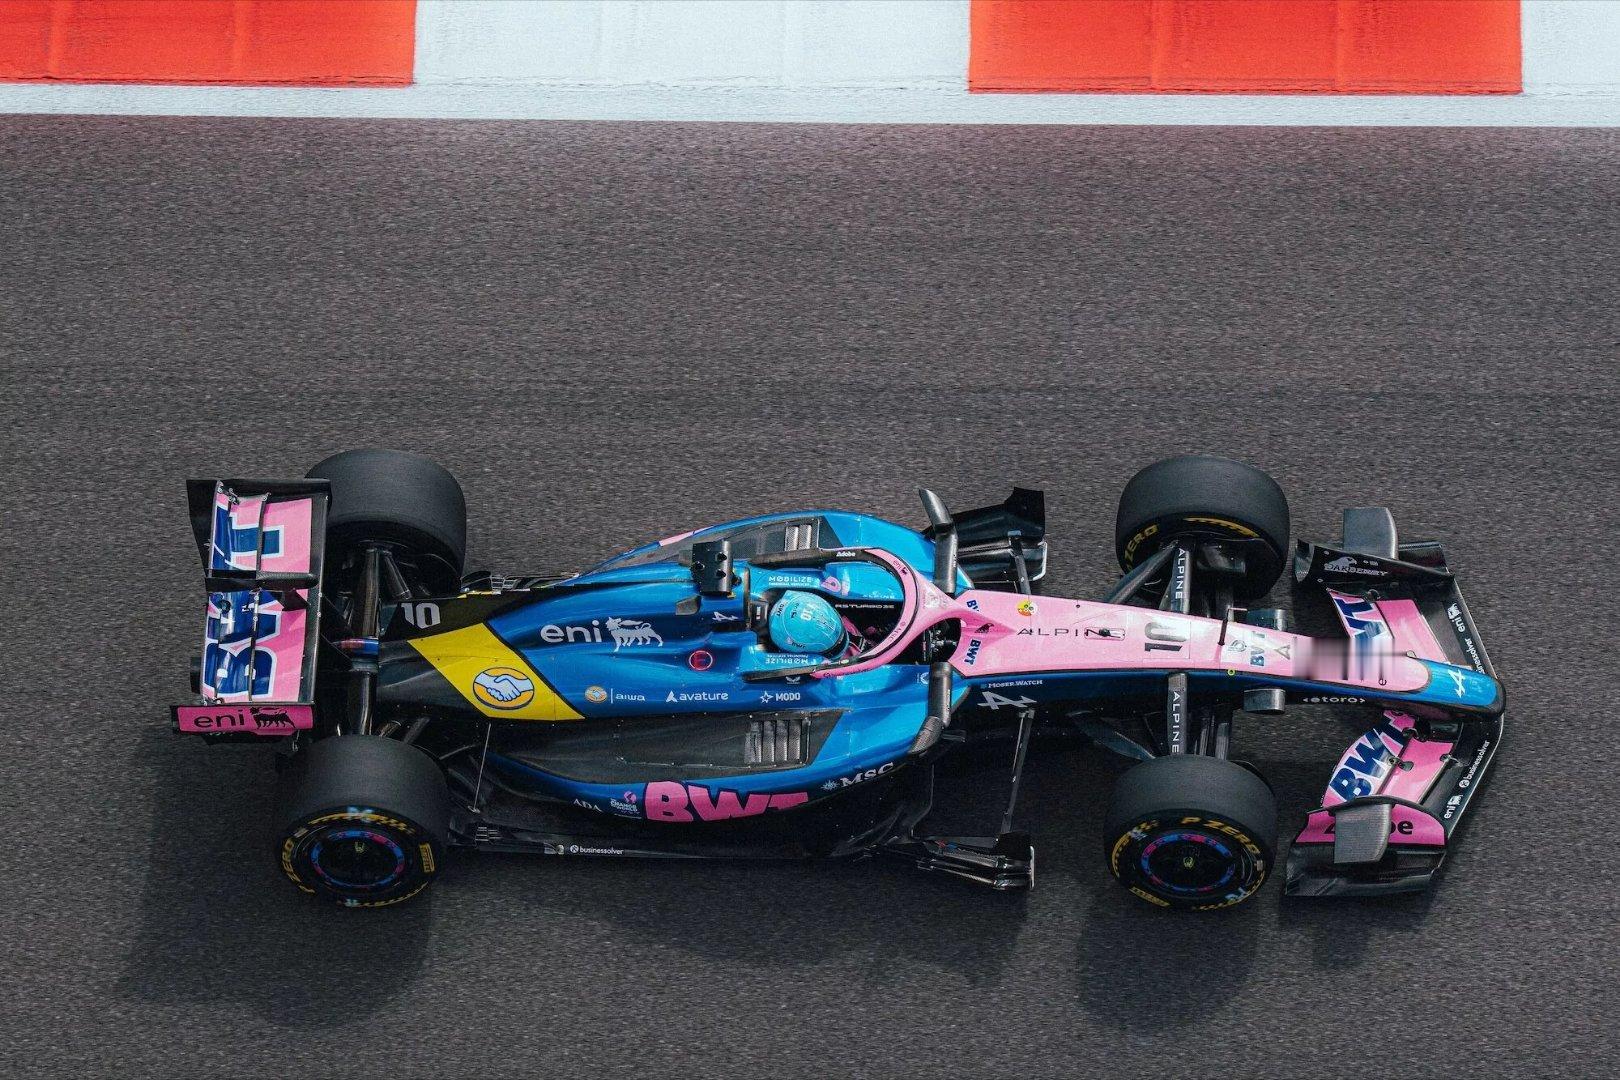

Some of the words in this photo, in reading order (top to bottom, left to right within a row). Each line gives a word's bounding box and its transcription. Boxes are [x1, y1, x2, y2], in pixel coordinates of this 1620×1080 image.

[1174, 548, 1186, 600] ALPINE
[401, 602, 441, 629] 10
[1452, 616, 1466, 633] eni
[540, 619, 603, 644] eni
[963, 638, 982, 666] BWT
[679, 691, 729, 701] avature
[775, 692, 801, 701] MODO
[193, 709, 245, 728] eni
[1172, 690, 1181, 754] ALPINE
[1463, 739, 1491, 781] businessolver
[840, 761, 894, 788] MSC
[645, 780, 808, 821] BWT
[1443, 804, 1457, 819] eni
[580, 845, 625, 856] businessolver
